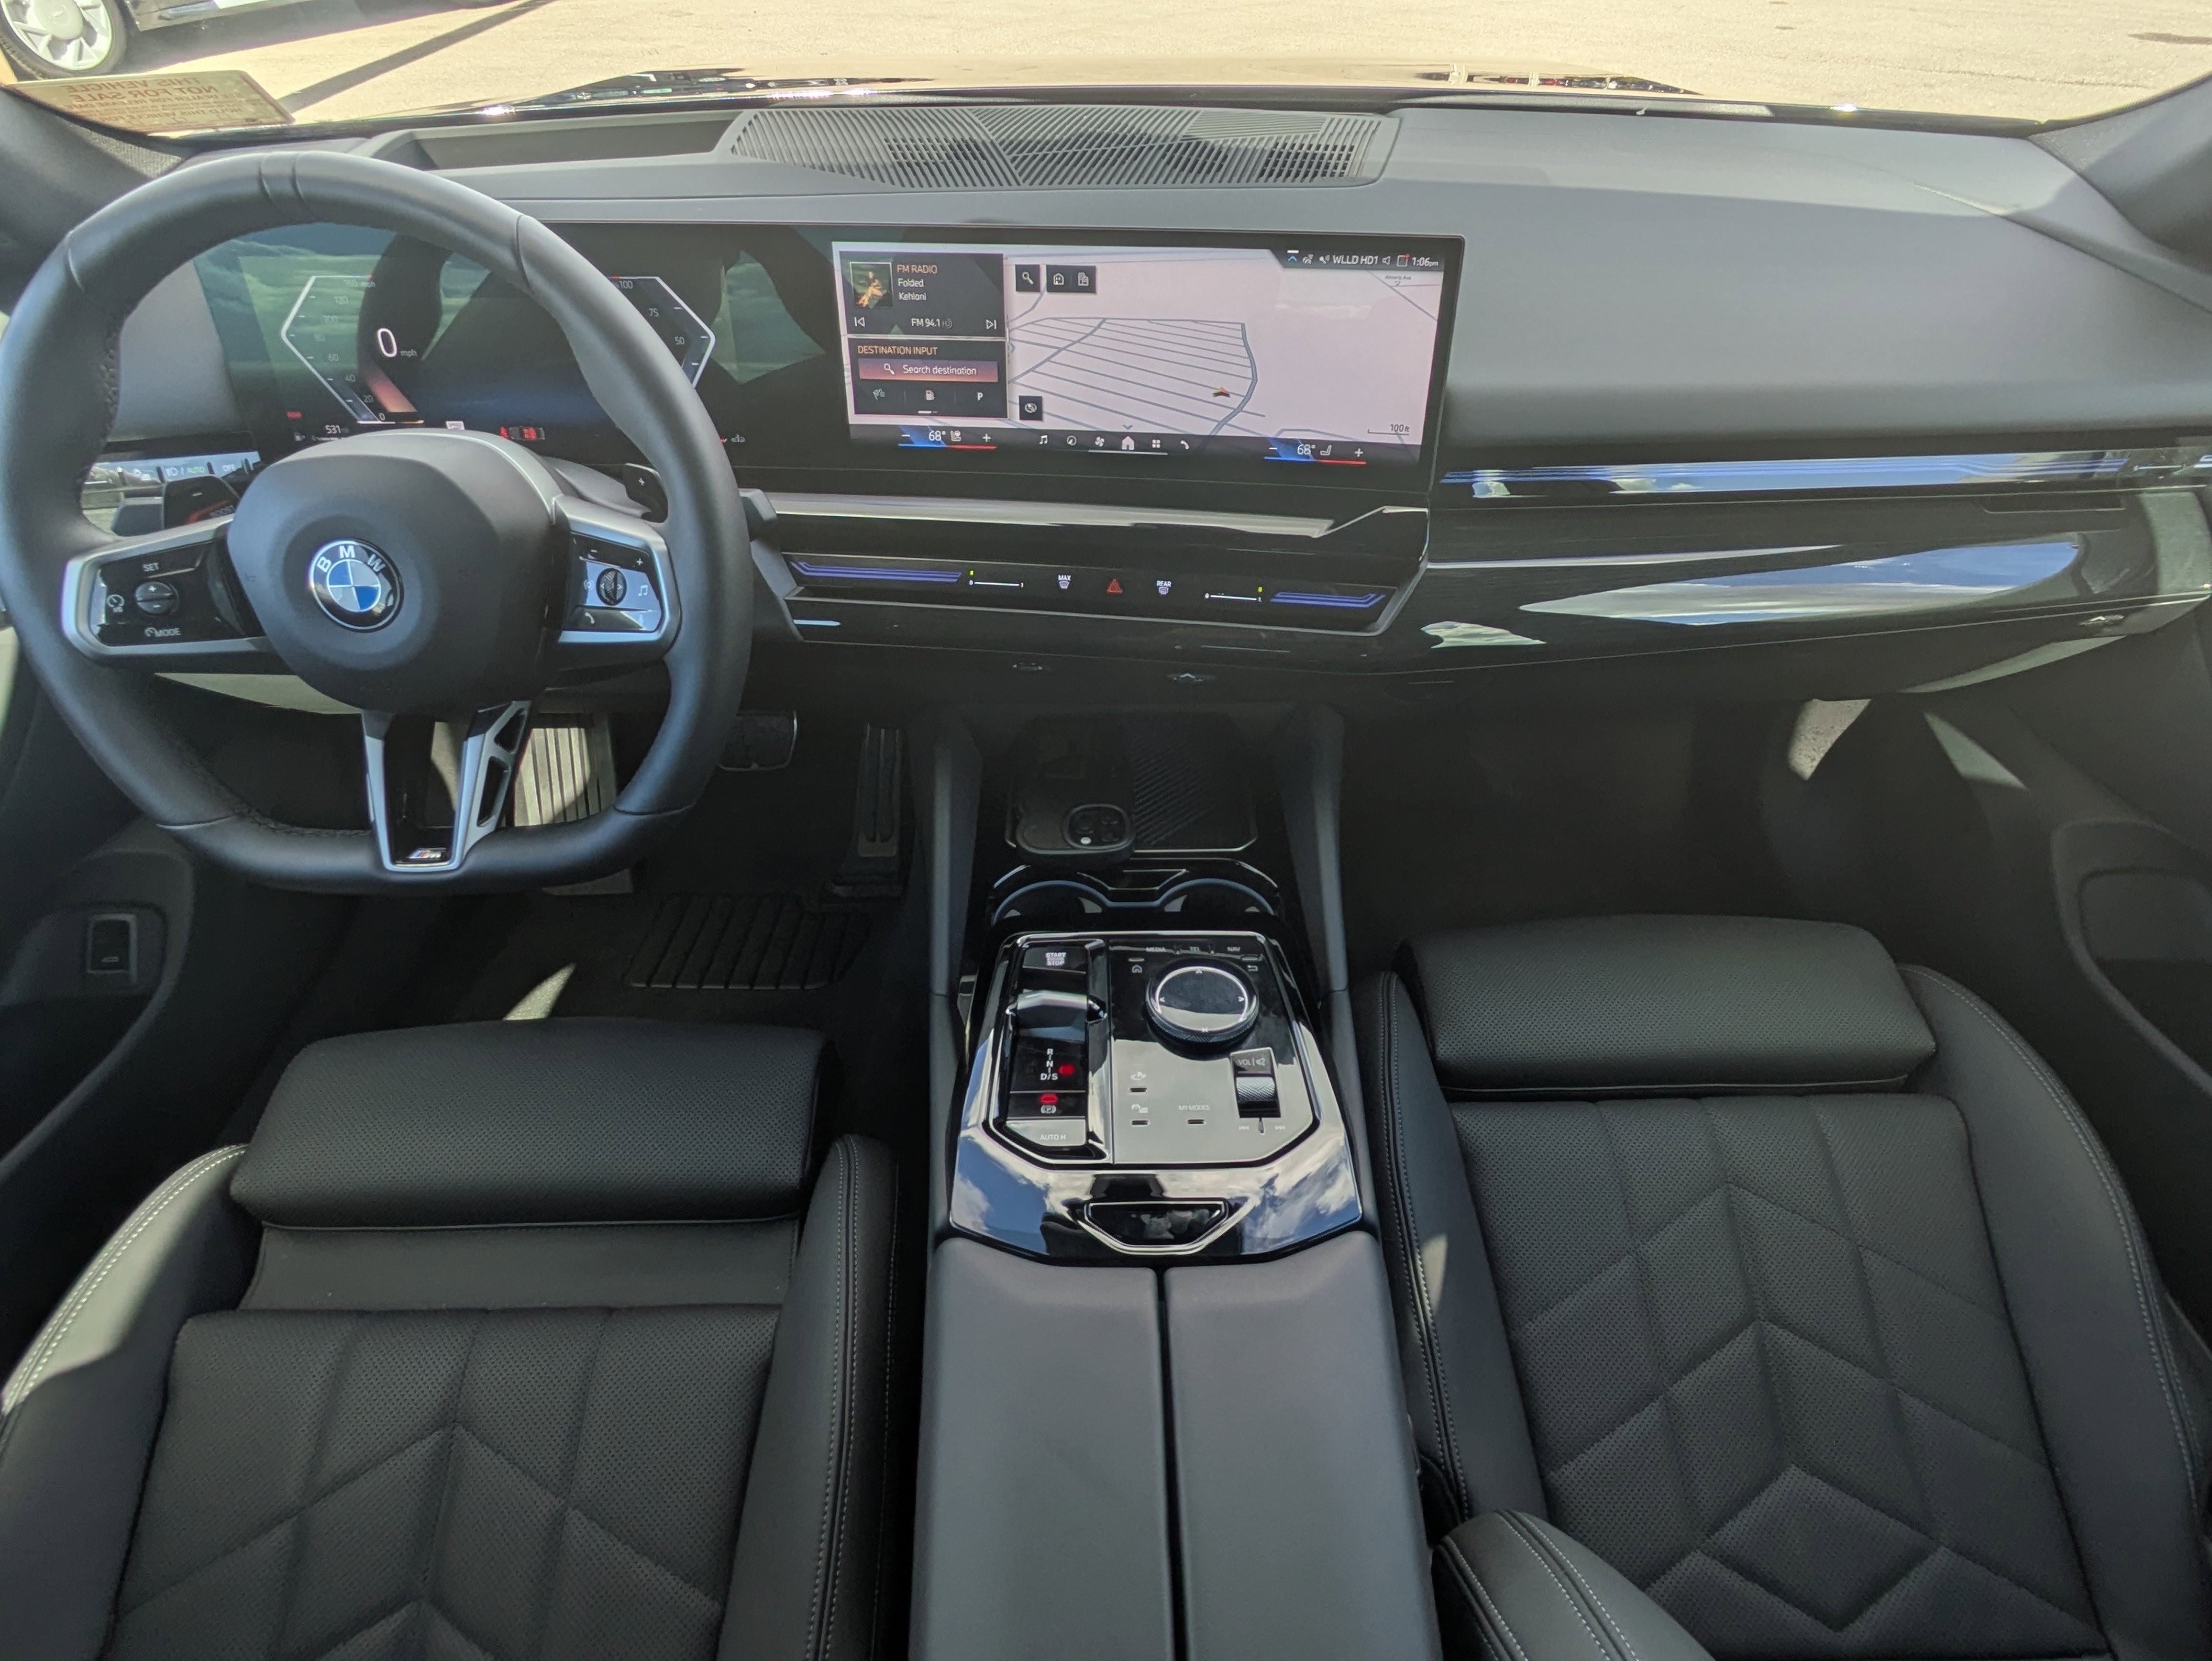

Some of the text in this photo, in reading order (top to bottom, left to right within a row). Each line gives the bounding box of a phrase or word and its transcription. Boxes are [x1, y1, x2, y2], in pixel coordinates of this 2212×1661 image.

[1333, 255, 1378, 265] WLLD HD1
[1412, 256, 1438, 267] 1:06pm
[897, 265, 938, 275] FM RADIO
[898, 278, 924, 288] Folded
[334, 296, 348, 304] 120
[899, 292, 927, 301] Kehlani
[649, 308, 659, 317] 75
[324, 315, 338, 323] 100
[911, 318, 924, 327] FM
[925, 319, 940, 327] 94.1
[314, 333, 325, 342] 80
[675, 337, 685, 345] 50
[376, 327, 418, 358] 0 mph
[857, 345, 938, 355] DESTINATION INPUT
[328, 353, 339, 362] 60
[903, 364, 977, 375] Search destination
[344, 374, 356, 383] 40
[364, 395, 374, 404] 20
[378, 412, 386, 421] 0
[325, 425, 341, 434] 531
[929, 431, 946, 442] 68°
[1297, 444, 1316, 456] 68°
[317, 545, 386, 572] BMW
[143, 562, 159, 572] SET
[155, 627, 181, 637] MODE
